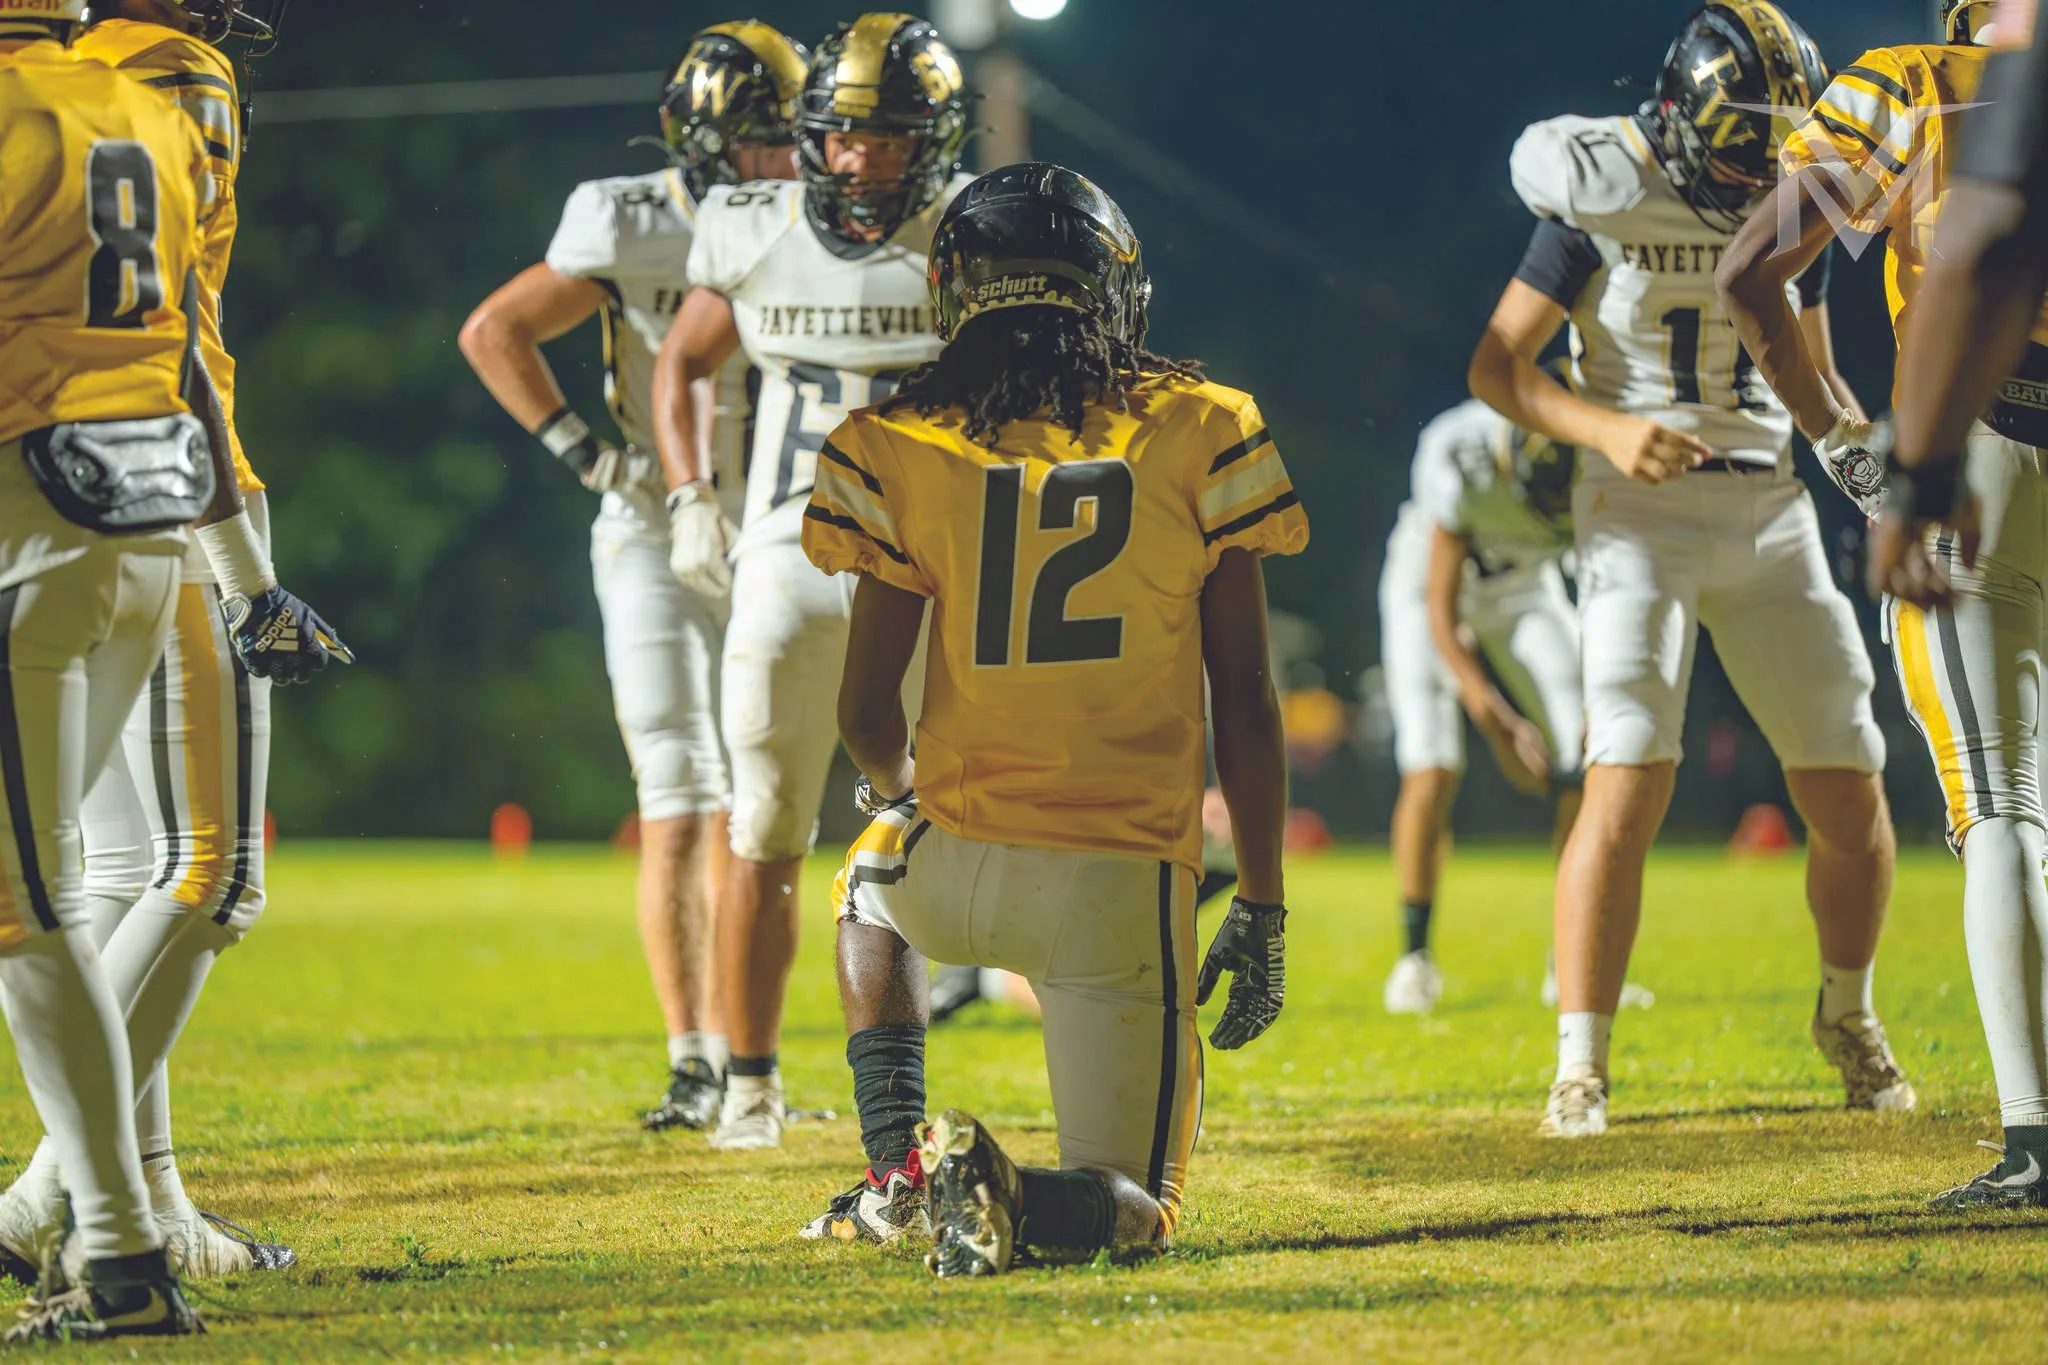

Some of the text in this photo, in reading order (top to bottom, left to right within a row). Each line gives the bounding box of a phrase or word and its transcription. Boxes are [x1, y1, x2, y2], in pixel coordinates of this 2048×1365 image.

[84, 138, 166, 331] 8
[255, 606, 293, 654] adidas
[972, 457, 1137, 669] 12
